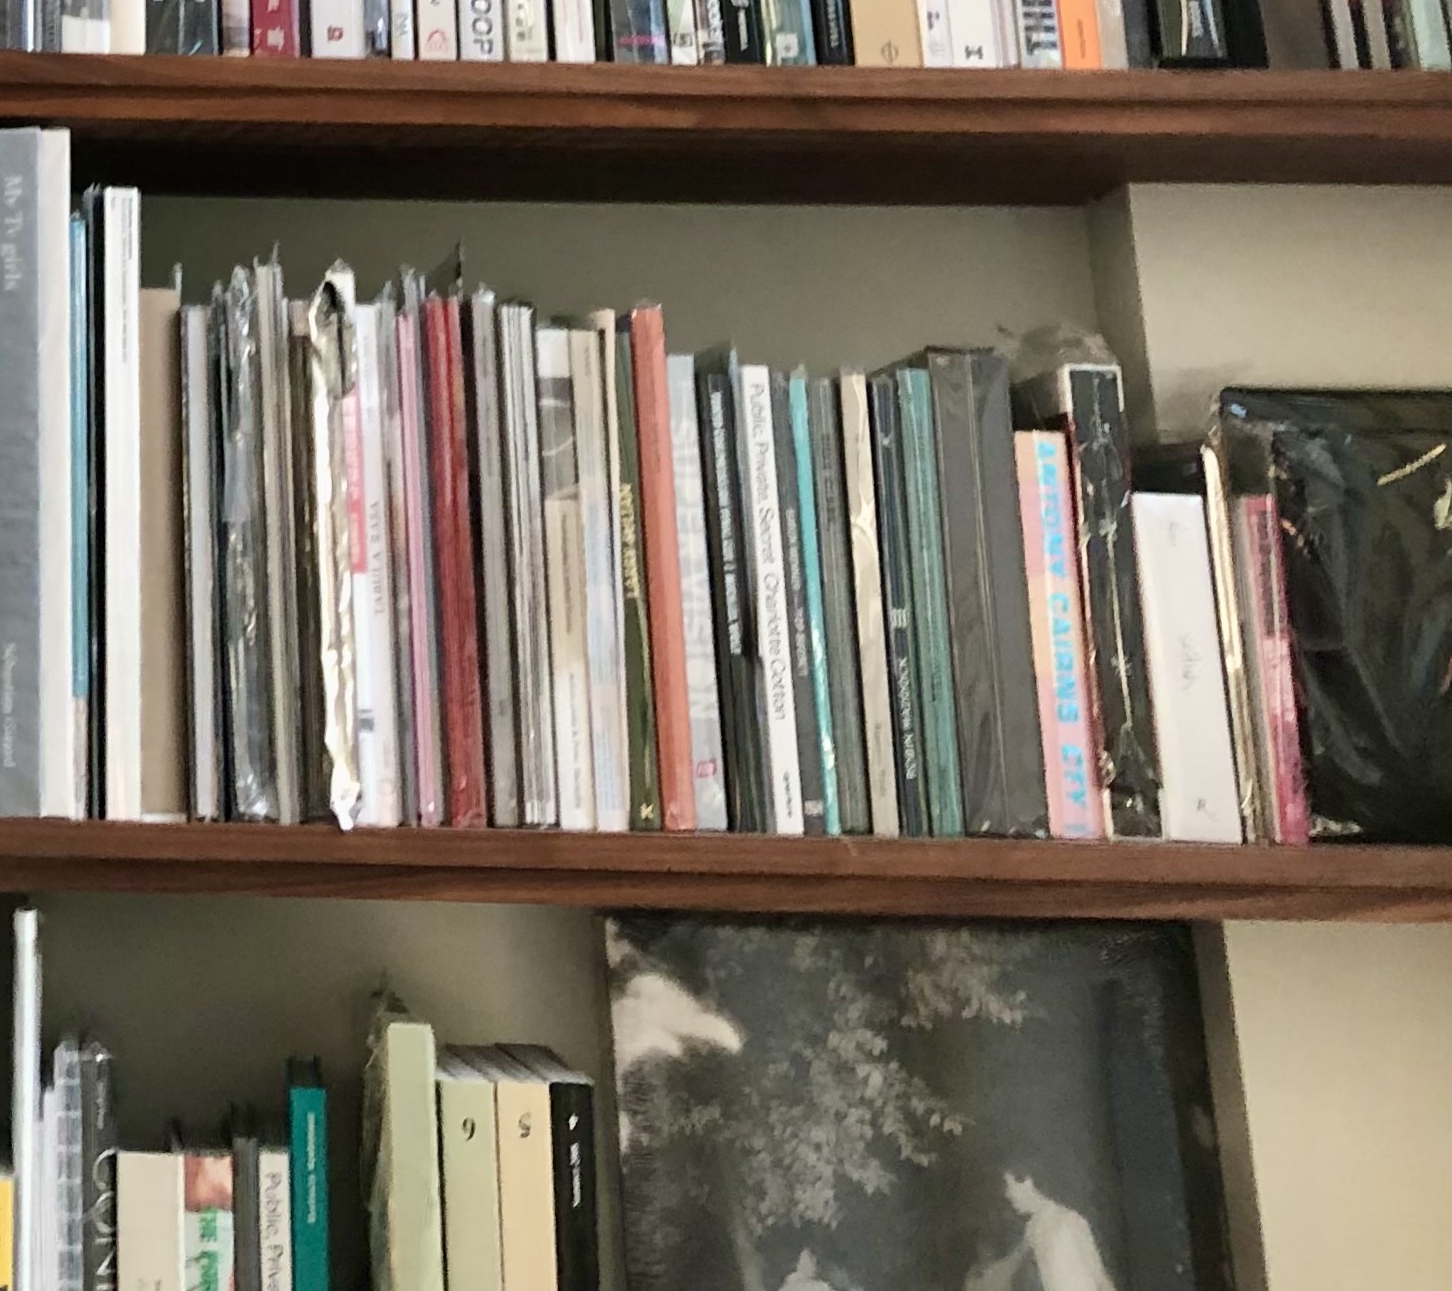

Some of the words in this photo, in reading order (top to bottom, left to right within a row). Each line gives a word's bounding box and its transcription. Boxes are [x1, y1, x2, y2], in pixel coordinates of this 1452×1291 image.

[0, 175, 23, 207] My
[1033, 438, 1067, 580] ANTONY
[1046, 593, 1079, 726] CAIRNS
